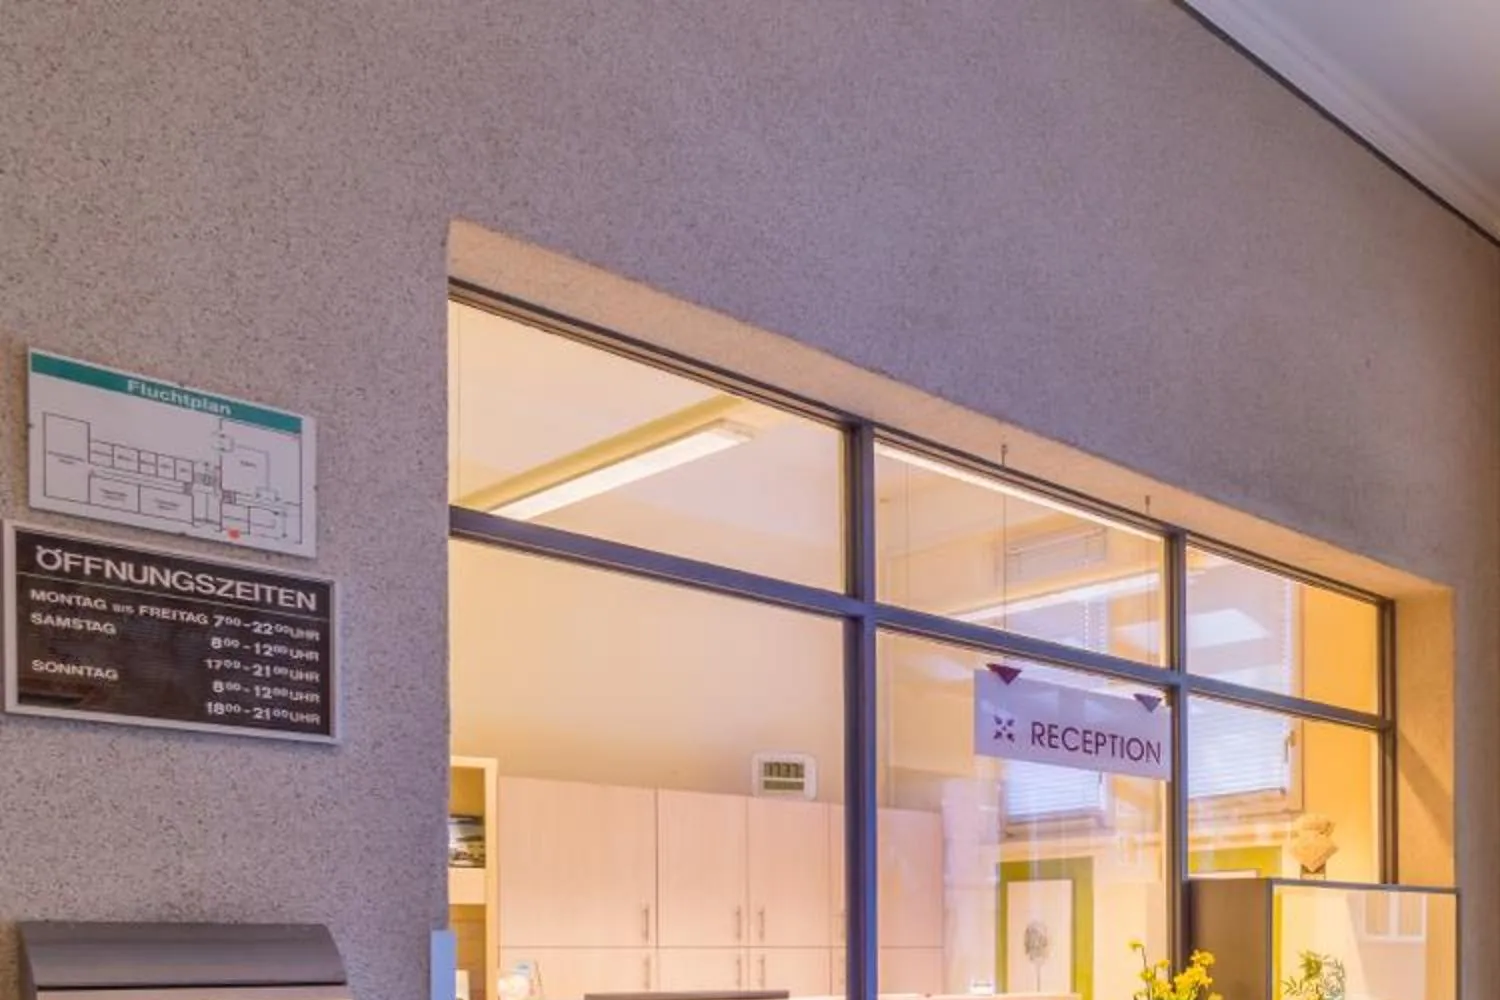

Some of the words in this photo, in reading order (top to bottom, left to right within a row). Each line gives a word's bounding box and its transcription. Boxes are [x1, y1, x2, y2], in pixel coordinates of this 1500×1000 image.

[127, 378, 233, 416] Fluchtplan
[36, 545, 317, 611] ÖFFNUNGSZEITEN
[30, 589, 107, 611] MONTAG
[138, 604, 208, 625] FREITAG
[30, 612, 117, 635] SAMSTAG
[31, 659, 119, 681] SONNTAG
[1030, 721, 1162, 765] RECEPTION
